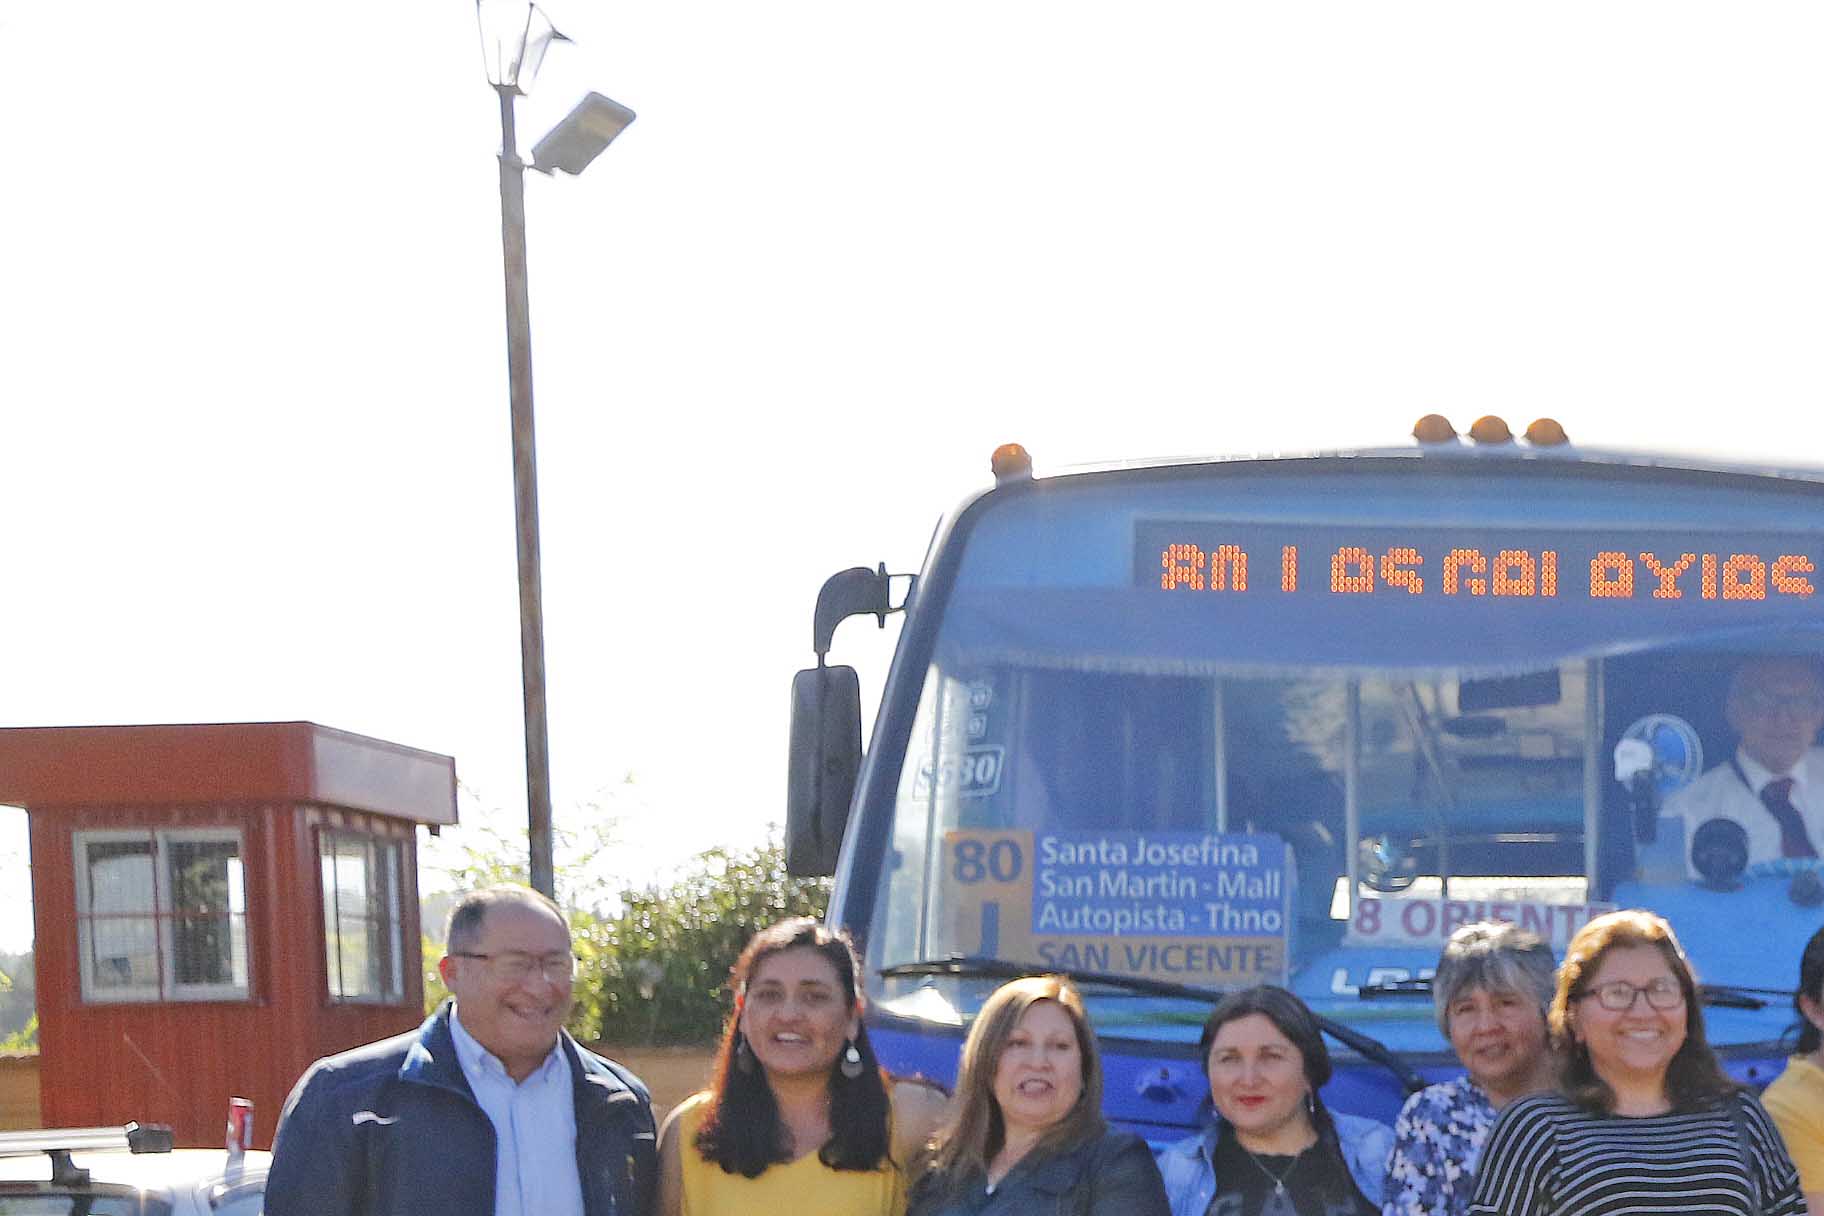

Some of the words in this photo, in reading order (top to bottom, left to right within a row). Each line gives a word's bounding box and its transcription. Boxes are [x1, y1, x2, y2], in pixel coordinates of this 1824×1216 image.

[952, 839, 1022, 884] 80
[1041, 836, 1128, 865] Santa
[1132, 836, 1259, 866] Josefina
[1040, 870, 1093, 898] San
[1217, 870, 1280, 899] Mall
[1038, 902, 1185, 935] Autopista
[1205, 903, 1282, 932] Thno
[1354, 898, 1382, 936] 8
[1401, 898, 1611, 937] ORIENT
[1038, 942, 1109, 972] SAN
[1127, 944, 1273, 975] VICENTE
